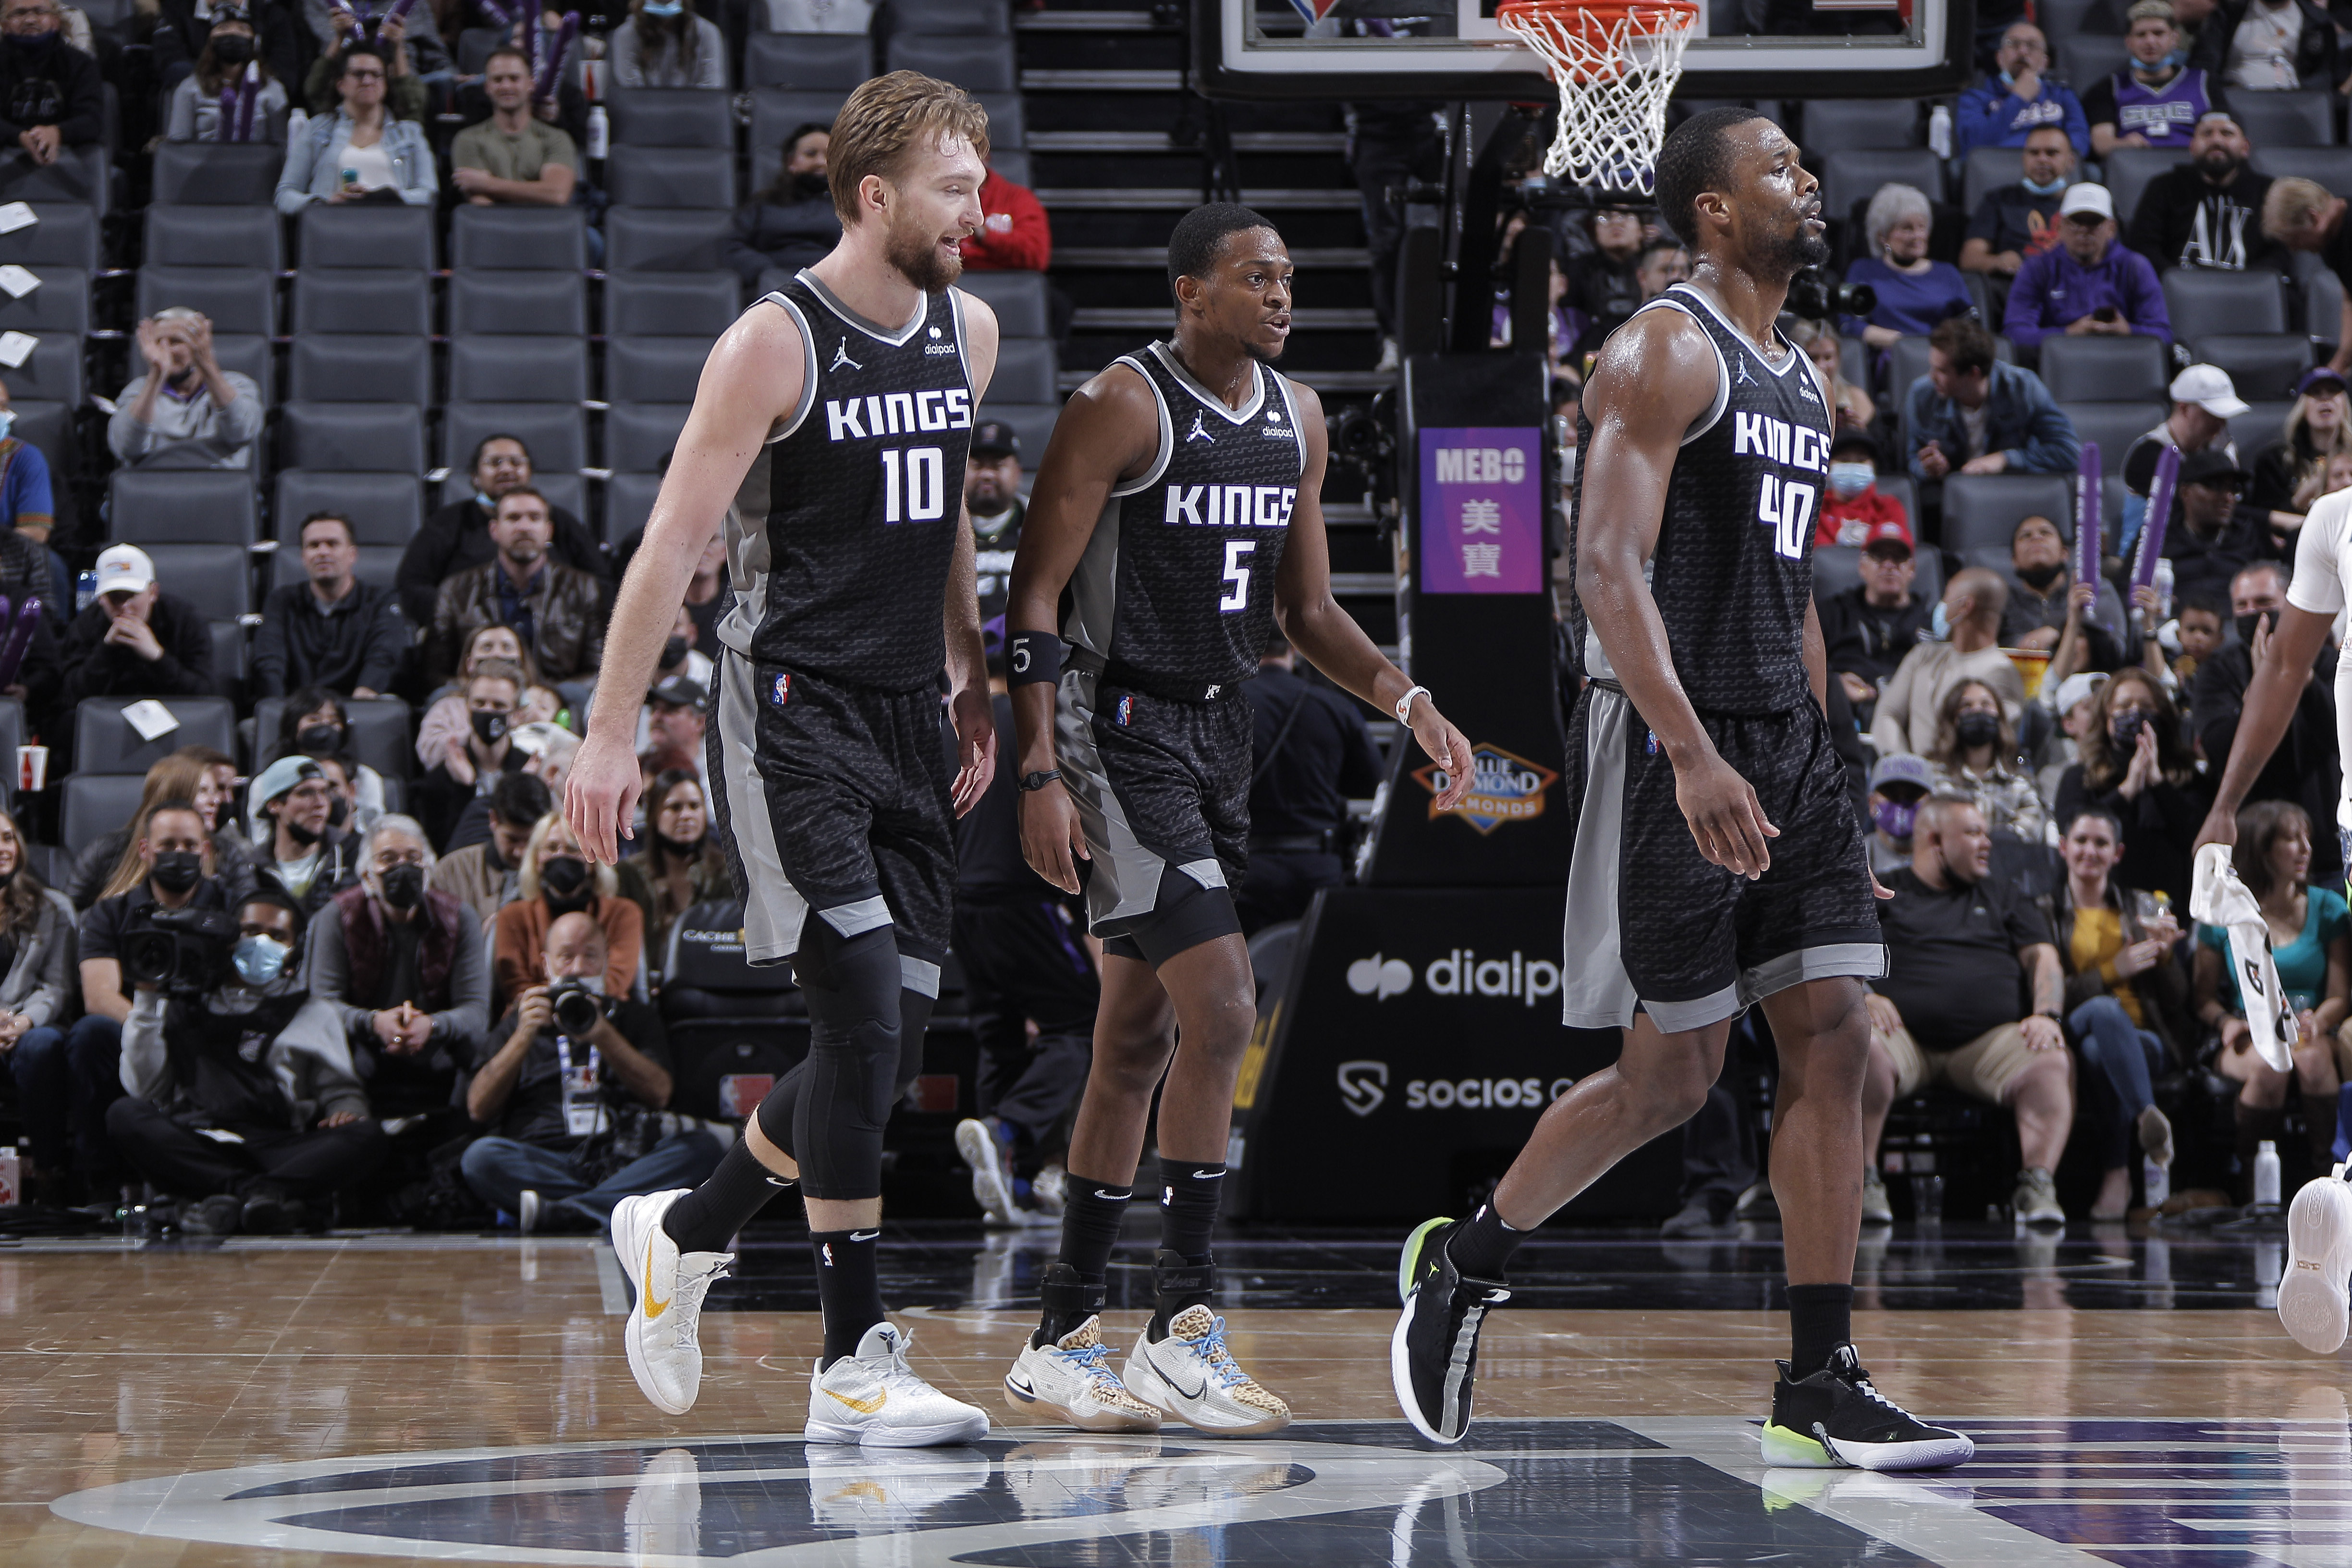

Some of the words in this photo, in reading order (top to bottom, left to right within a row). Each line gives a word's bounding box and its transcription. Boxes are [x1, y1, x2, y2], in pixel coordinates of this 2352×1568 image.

[925, 343, 956, 356] dialpad
[825, 388, 971, 441] KINGS
[1262, 426, 1294, 439] dialpad
[1435, 448, 1526, 484] MEBO
[881, 446, 945, 524] 10
[1164, 484, 1298, 527] KINGS
[1758, 473, 1817, 561] 40
[1219, 539, 1258, 612] 5
[1013, 637, 1031, 673] 5
[1433, 772, 1541, 794] DMOND
[1473, 758, 1514, 775] LUE
[683, 930, 738, 943] CACHE
[1426, 948, 1564, 1007] dialp
[1406, 1078, 1544, 1109] SOCIOS
